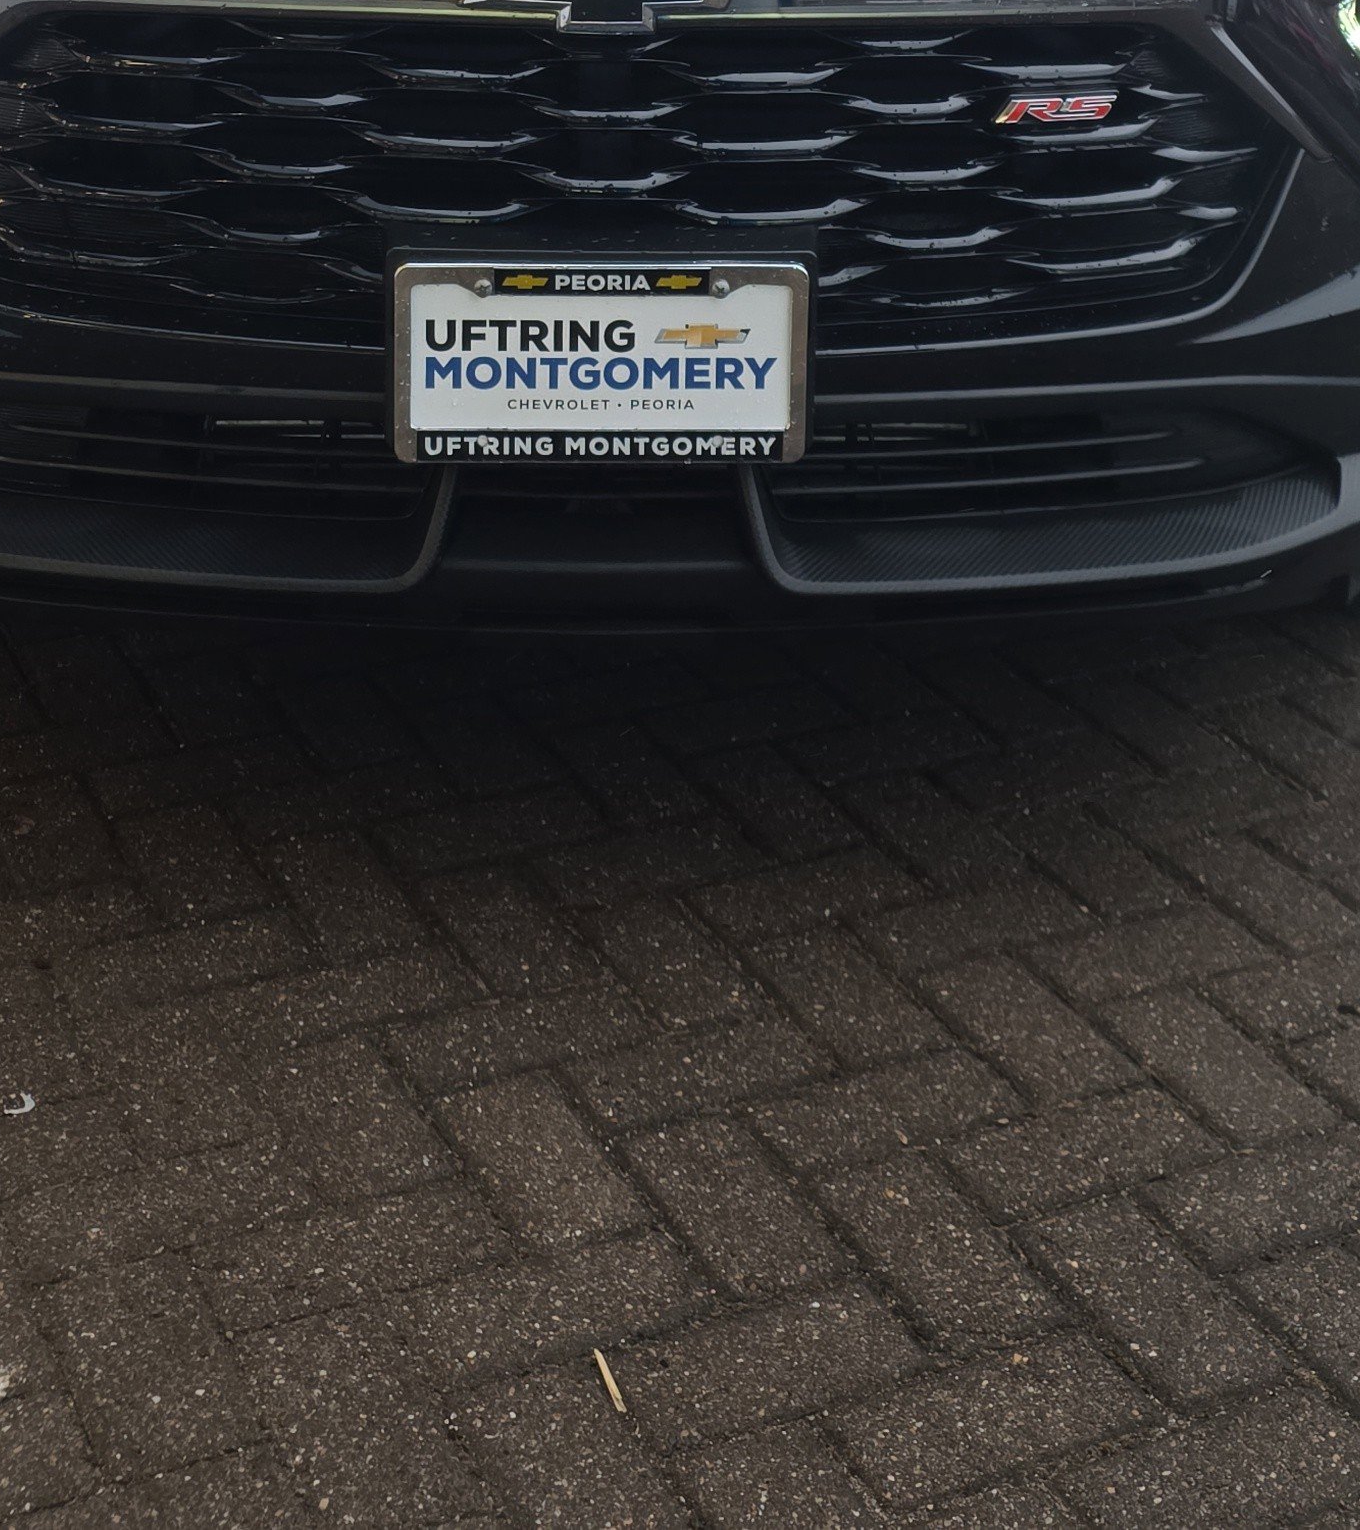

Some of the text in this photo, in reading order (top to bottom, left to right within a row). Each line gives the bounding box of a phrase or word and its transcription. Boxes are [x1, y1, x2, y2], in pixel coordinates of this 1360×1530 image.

[995, 93, 1118, 124] RS
[555, 274, 651, 292] PEORIA
[424, 319, 636, 353] UFTRING
[424, 356, 778, 390] MONTGOMERY
[507, 399, 695, 411] CHEVROLET PEORIA
[424, 436, 777, 456] UFTRING MONTGOMERY
